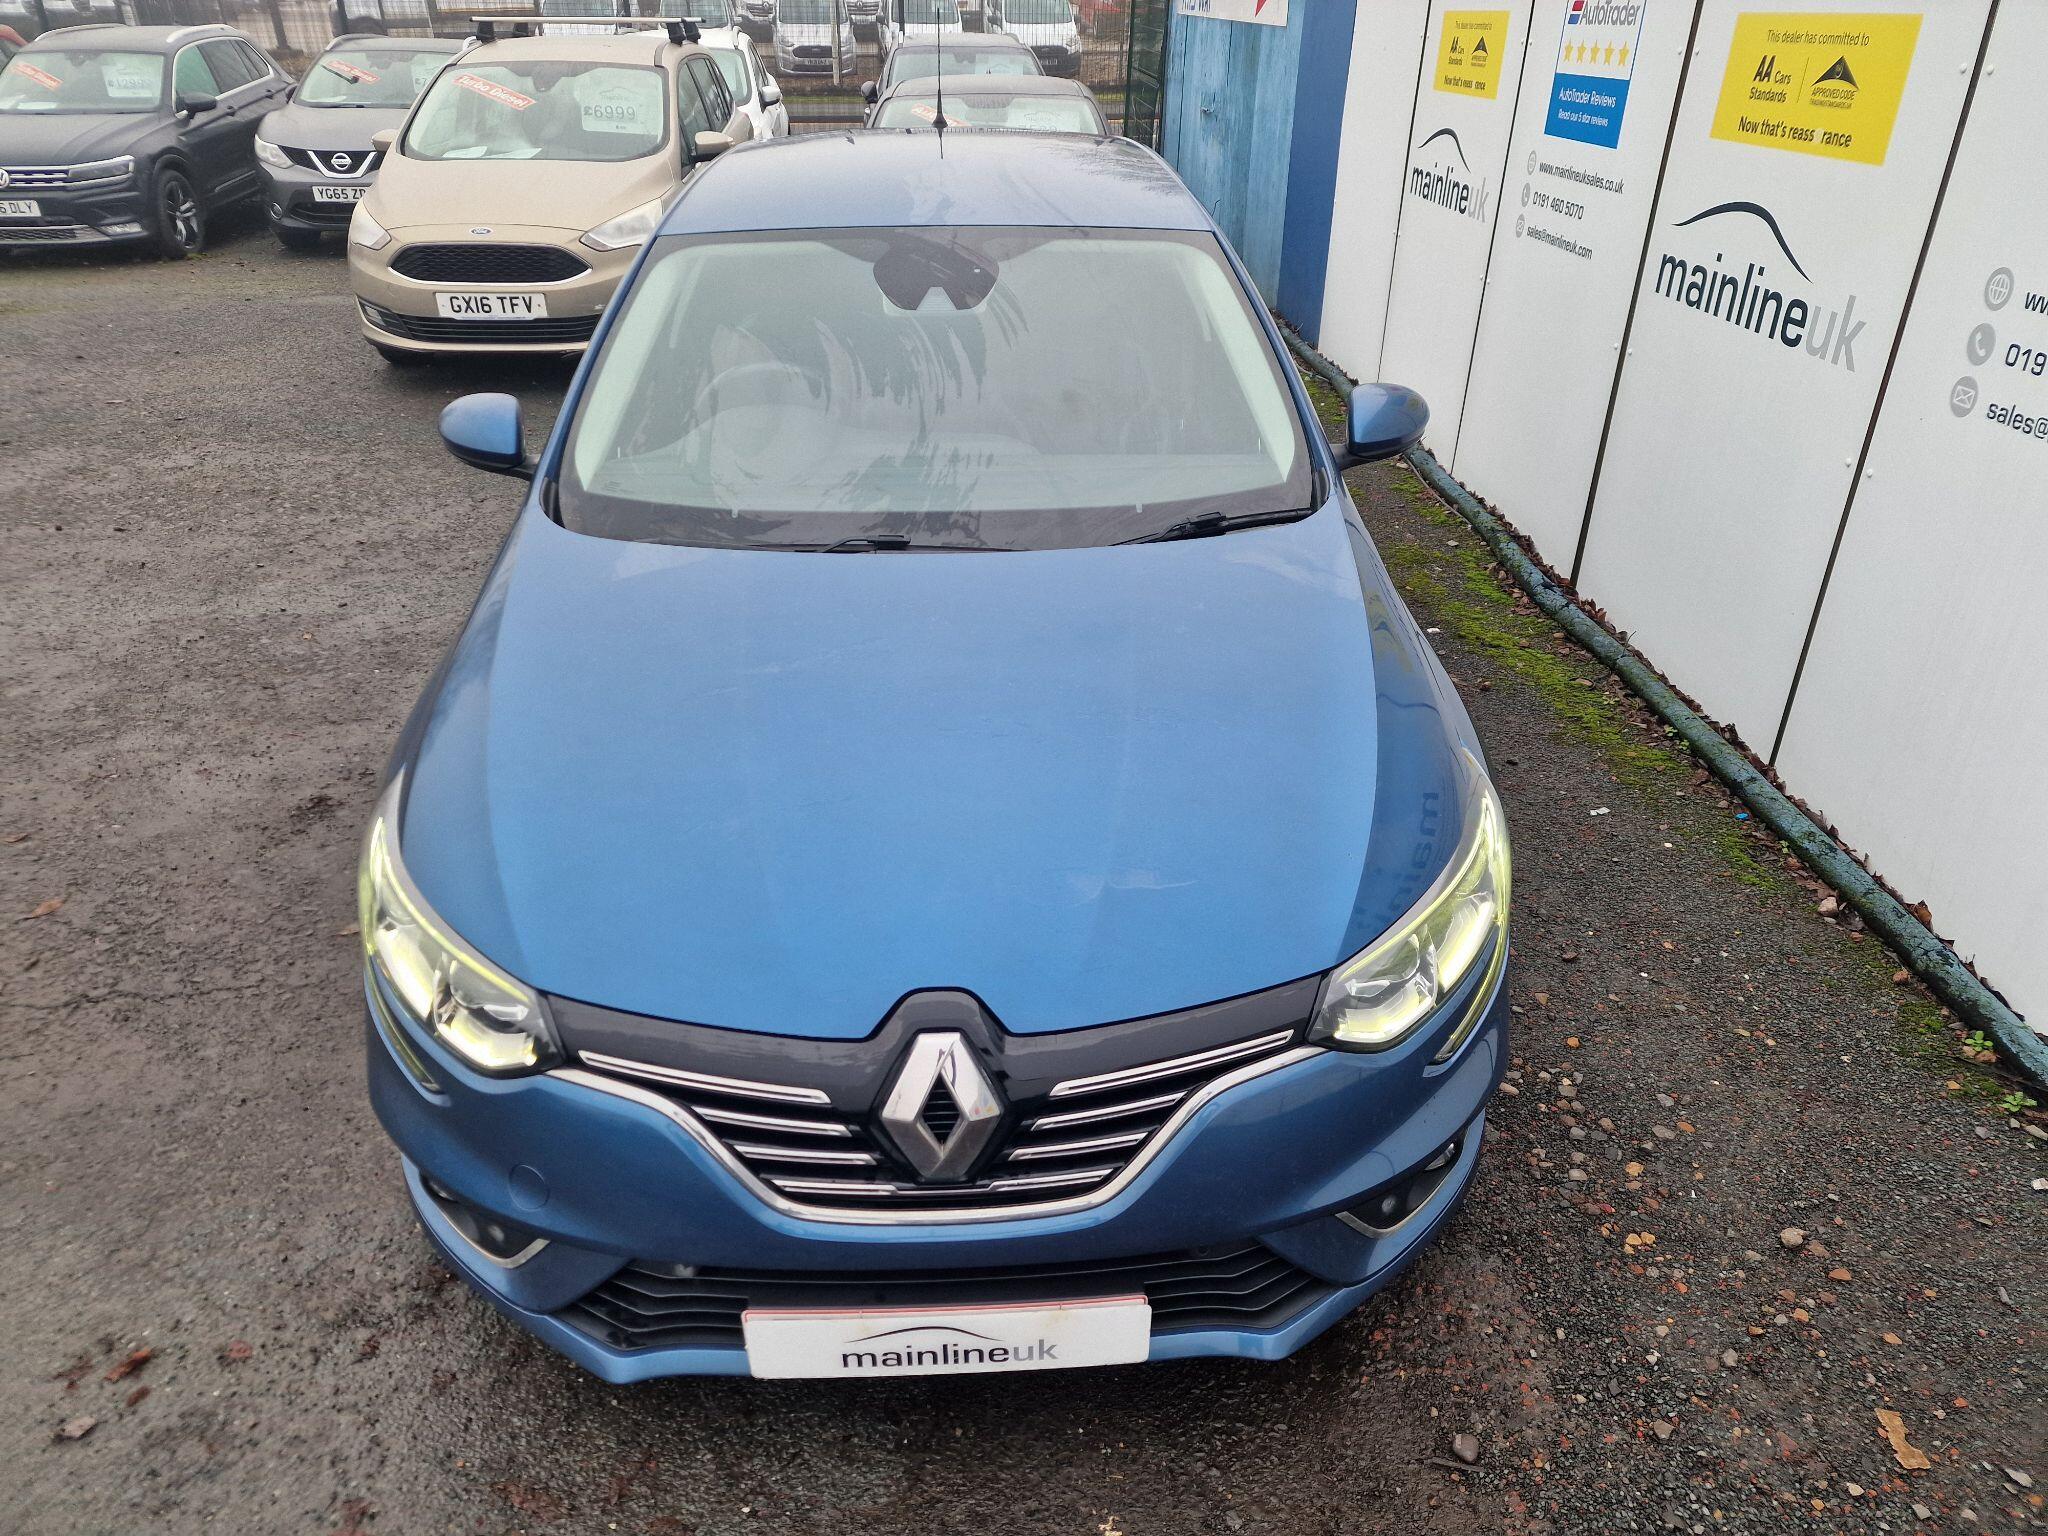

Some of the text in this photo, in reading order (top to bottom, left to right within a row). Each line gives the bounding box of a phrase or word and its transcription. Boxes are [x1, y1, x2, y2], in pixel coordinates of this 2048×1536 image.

[1580, 0, 1641, 25] AutoTrader
[1767, 29, 1870, 46] This dealer has committed to
[1753, 55, 1792, 84] AA Cars
[459, 76, 529, 107] Turbo Diesel
[1590, 91, 1617, 108] Reviews
[1749, 86, 1788, 103] Standards
[583, 105, 636, 120] £6999
[1738, 115, 1852, 148] Now that's reassrance
[1410, 162, 1489, 223] mainlineuk
[1539, 162, 1624, 194] www.mainlineuksales.co.uk
[9, 202, 32, 213] DLY
[317, 188, 349, 200] YG65
[1532, 192, 1584, 220] 0191 460 5070
[1527, 225, 1592, 259] sales@mainlineuk.com
[450, 295, 532, 313] GX16 TFV
[1655, 252, 1867, 372] mainlineuk
[2005, 343, 2048, 376] 019
[1987, 403, 2048, 443] sales@
[842, 1338, 1059, 1369] mainlineuk
